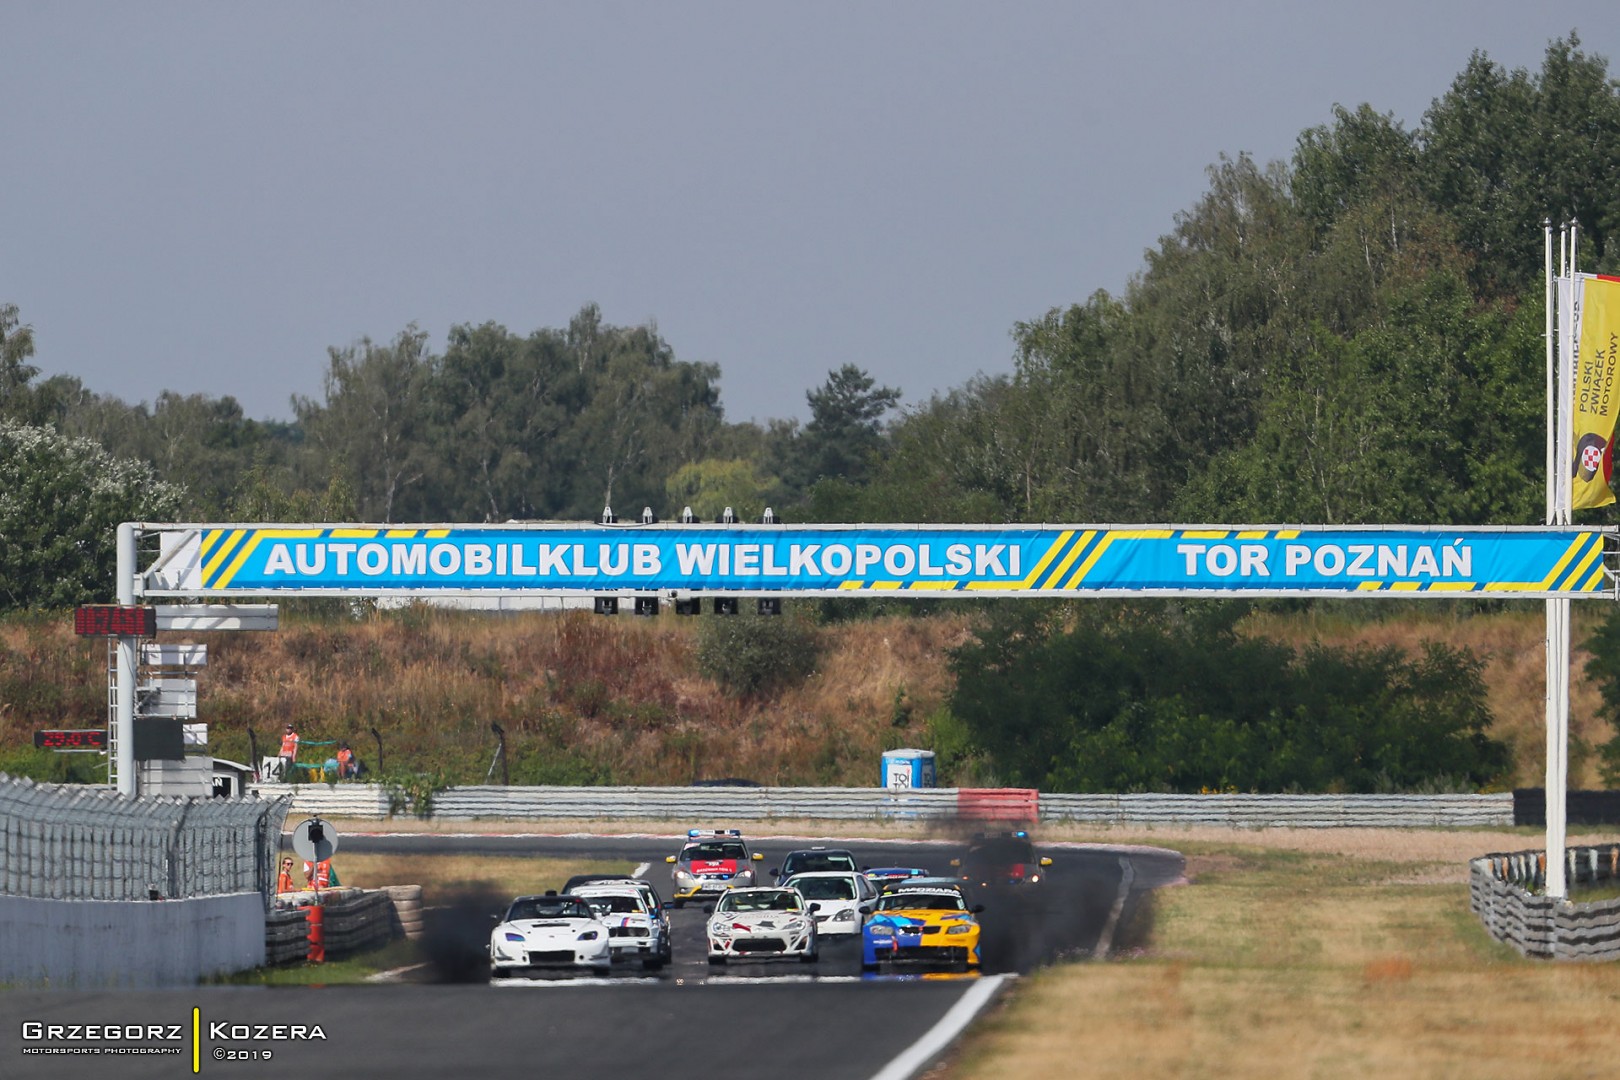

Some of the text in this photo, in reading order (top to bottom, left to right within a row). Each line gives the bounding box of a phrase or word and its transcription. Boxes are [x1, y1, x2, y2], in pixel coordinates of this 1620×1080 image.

[1579, 361, 1594, 413] POLSKI
[1590, 349, 1606, 415] ZWIĄZEK
[1599, 332, 1619, 417] MOTOROWY
[263, 543, 1021, 577] AUTOMOBILKLUB WIELKOPOLSKI
[1177, 538, 1472, 577] TOR POZNAŃ
